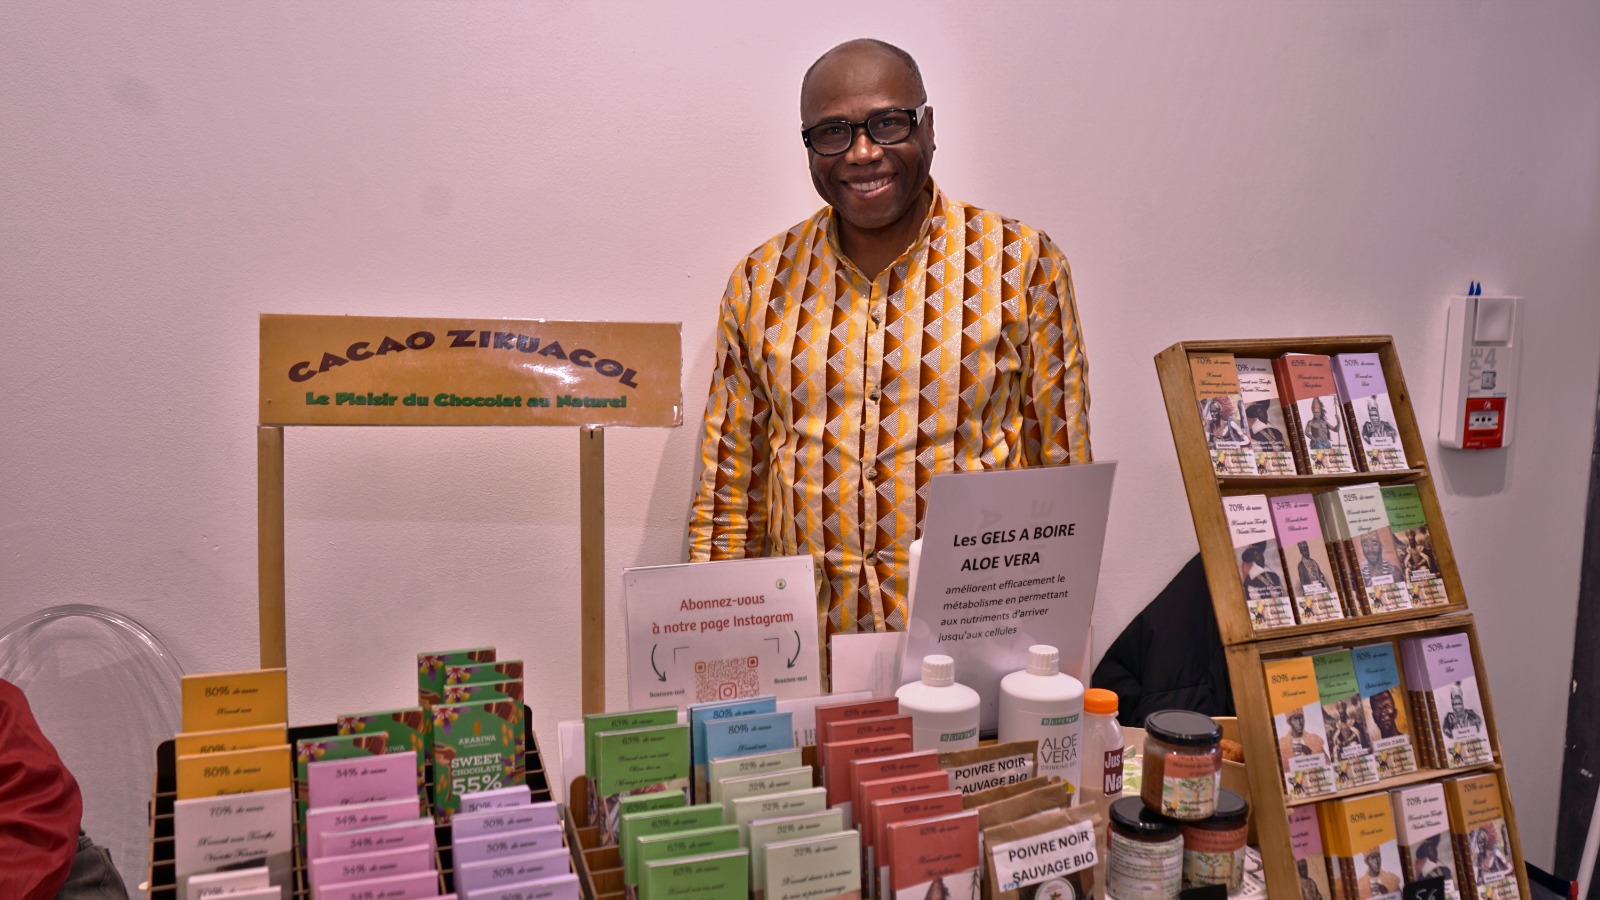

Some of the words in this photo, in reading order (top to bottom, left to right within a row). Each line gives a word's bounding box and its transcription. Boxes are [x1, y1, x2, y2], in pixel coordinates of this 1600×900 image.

[288, 330, 436, 382] CACAO
[447, 330, 640, 389] ZIKUACOL
[1484, 348, 1497, 368] 4
[1468, 348, 1484, 396] TYPE
[306, 392, 330, 406] Le
[336, 392, 398, 406] Plaisir
[403, 393, 428, 406] du
[434, 393, 522, 408] Chocolat
[527, 396, 550, 408] au
[556, 394, 627, 408] Naturel
[953, 534, 977, 547] Les
[981, 529, 1016, 545] GELS
[1019, 528, 1029, 541] A
[1033, 523, 1076, 539] BOIRE
[960, 556, 999, 572] ALOE
[1004, 552, 1040, 567] VERA
[945, 582, 997, 595] améliorent
[999, 574, 1055, 590] efficacement
[1057, 574, 1065, 584] le
[680, 595, 765, 611] Abonnez-vous
[943, 597, 1003, 611] métabolisme
[1018, 590, 1068, 605] permettant
[652, 622, 660, 635] à
[664, 619, 696, 633] notre
[700, 619, 730, 634] page
[733, 611, 794, 631] Instagram
[940, 617, 958, 626] aux
[960, 612, 1010, 624] nutriments
[1012, 607, 1049, 618] d'arriver
[938, 630, 983, 643] jusqu'aux
[984, 626, 1017, 638] cellules
[1428, 643, 1444, 652] 50%
[1271, 674, 1289, 684] 80%
[204, 686, 229, 697] 80%
[713, 709, 732, 719] 80%
[728, 724, 748, 734] 80%
[458, 734, 497, 745] ARARIWA
[1040, 734, 1078, 750] ALOE
[451, 753, 502, 768] SWEET
[1041, 748, 1077, 763] VERA
[1105, 752, 1121, 769] Jus
[203, 766, 230, 778] 80%
[452, 764, 502, 777] CHOCOLATE
[955, 762, 996, 780] POIVRE
[998, 757, 1026, 770] NOIR
[452, 773, 502, 796] 55%
[1008, 773, 1028, 784] BIO
[1008, 840, 1056, 862] POIVRE
[1059, 831, 1090, 848] NOIR
[1013, 858, 1072, 884] SAUVAGE
[1074, 852, 1094, 867] BIO
